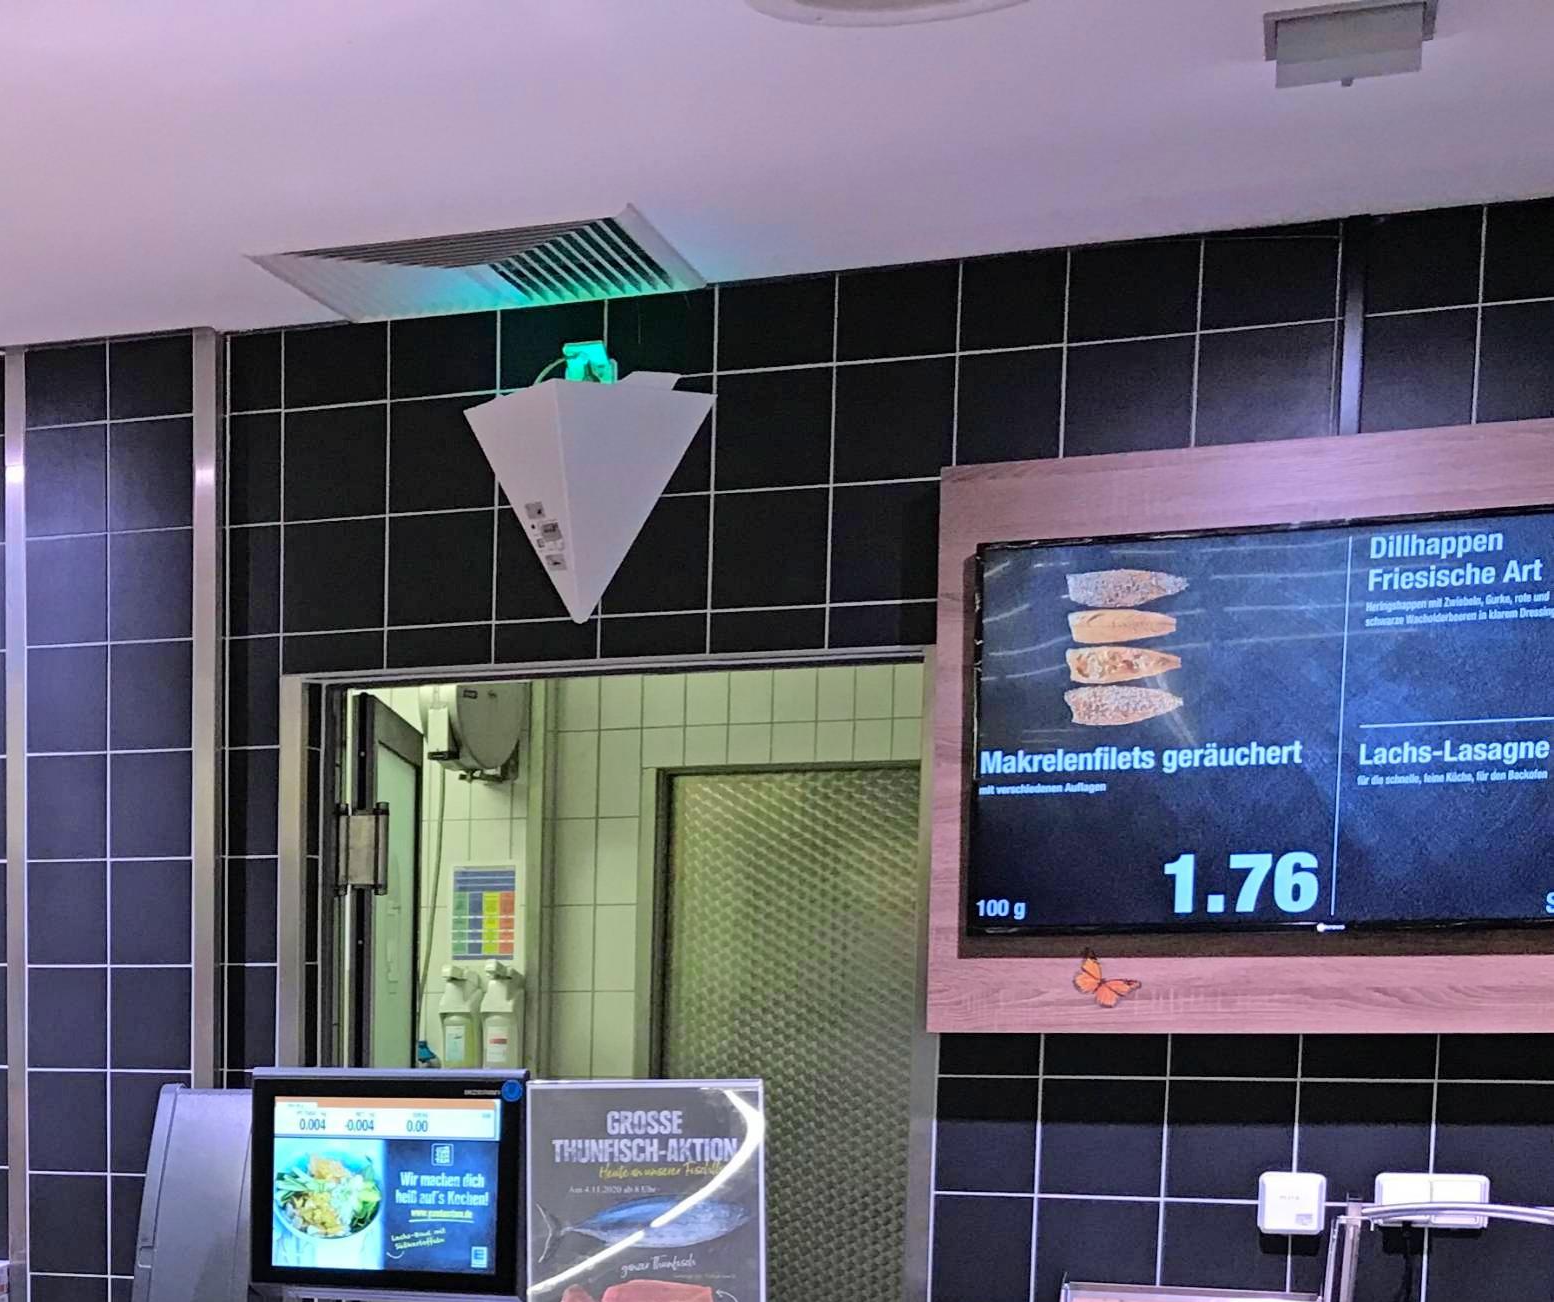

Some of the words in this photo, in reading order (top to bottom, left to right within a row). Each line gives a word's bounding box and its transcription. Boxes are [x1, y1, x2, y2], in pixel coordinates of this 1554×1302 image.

[1370, 533, 1503, 559] Dillhappen
[1368, 563, 1496, 592] Friesische
[1503, 559, 1543, 583] Art
[1429, 598, 1442, 608] mit
[1486, 594, 1513, 606] Gurke,
[1515, 592, 1532, 604] rote
[1533, 591, 1550, 602] und
[1365, 615, 1404, 627] schwarze
[1478, 609, 1487, 620] in
[1488, 608, 1518, 620] klarem
[981, 748, 1154, 775] Makrelenfilets
[1162, 740, 1303, 774] geräuchert
[1359, 740, 1550, 765] Lachs-Lasagne
[1371, 775, 1383, 785] die
[1476, 771, 1489, 781] für
[1491, 770, 1506, 780] den
[1508, 769, 1547, 780] Backofen
[979, 785, 995, 795] mit
[996, 783, 1063, 794] verschiedenen
[1064, 782, 1106, 793] Auflagen
[1164, 851, 1319, 914] 1.76
[976, 900, 1009, 917] 100
[1013, 902, 1026, 920] g
[299, 1118, 326, 1131] 0.004
[407, 1120, 428, 1132] 0.00
[607, 1110, 683, 1135] GROSSE
[552, 1138, 738, 1163] THUNFISCH-AKTION
[400, 1171, 418, 1186] Wir
[420, 1172, 460, 1187] machen
[463, 1173, 485, 1188] dich
[447, 1191, 489, 1206] Kochen!
